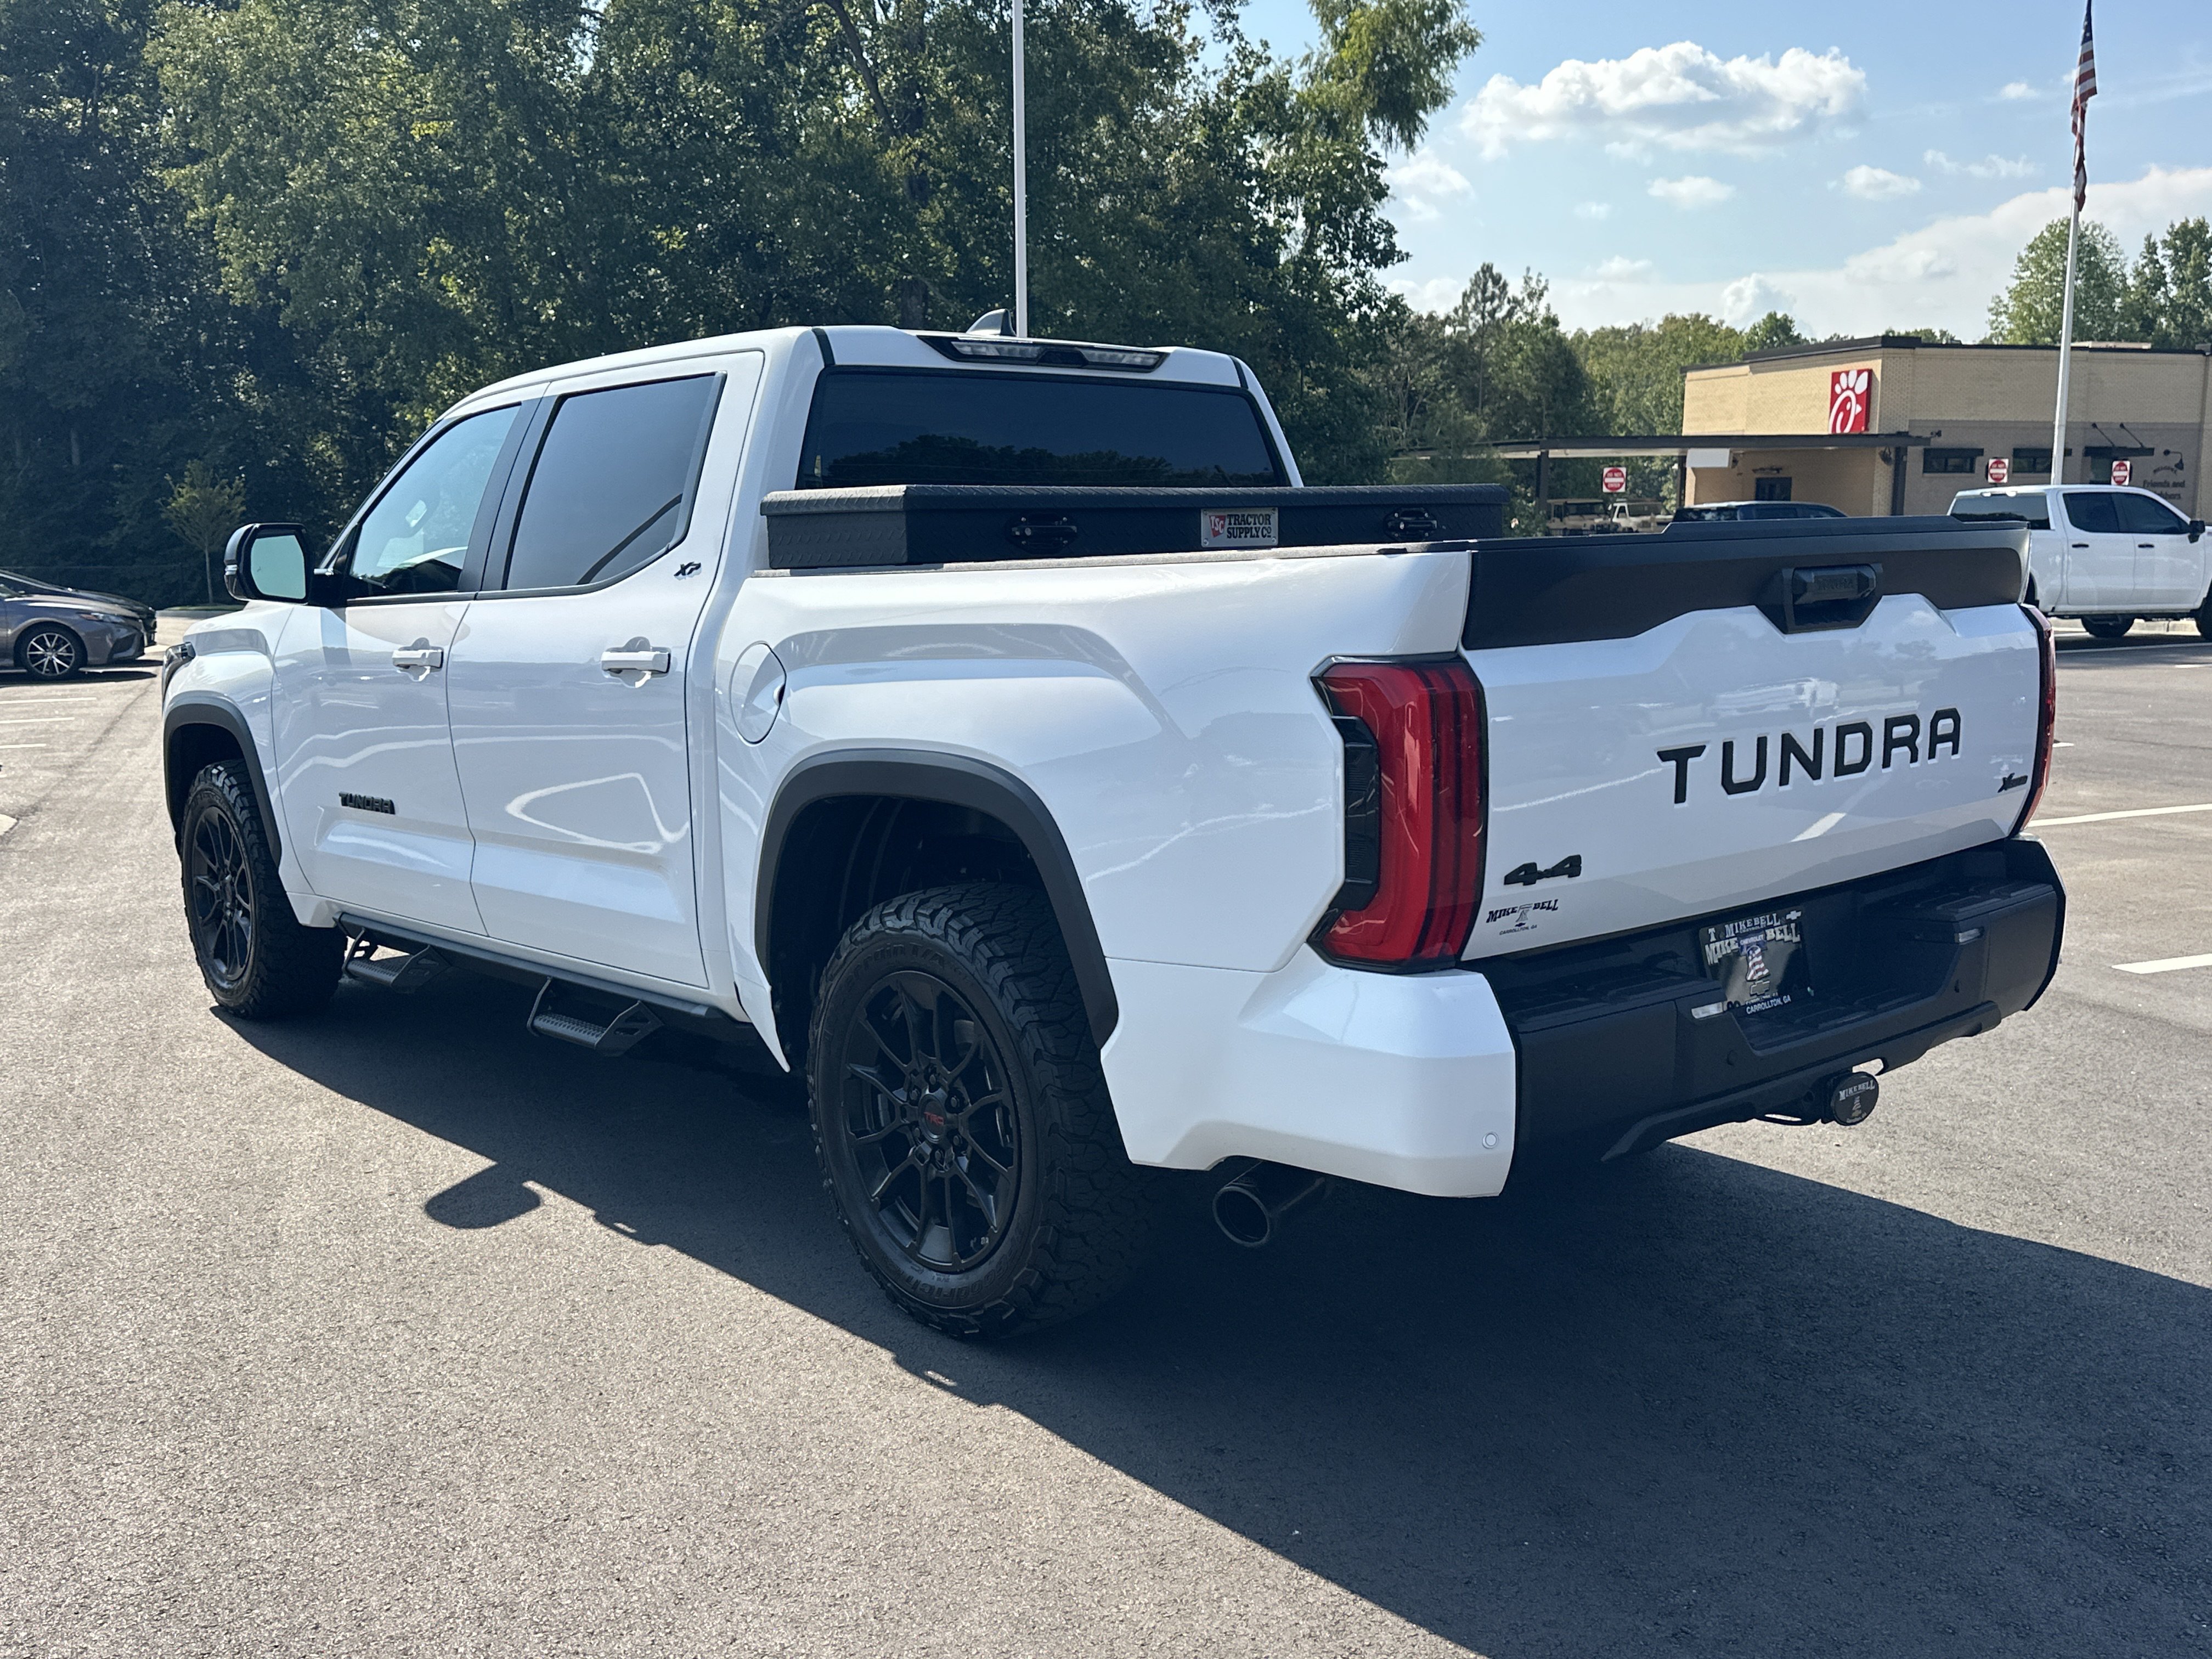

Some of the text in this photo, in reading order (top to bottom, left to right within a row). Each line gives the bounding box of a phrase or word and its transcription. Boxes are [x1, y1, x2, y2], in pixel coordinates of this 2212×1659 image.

[1210, 516, 1224, 533] TSC
[1227, 514, 1271, 526] TRACTOR
[1227, 526, 1260, 539] SUPPLY
[1656, 707, 1962, 805] TUNDRA
[338, 792, 396, 815] TUNDRA
[1486, 899, 1558, 923] MIKE BELL
[1724, 913, 1781, 938] MIKE BELL
[1705, 937, 1739, 966] MIKE
[1765, 923, 1801, 943] BELL
[1839, 1080, 1876, 1101] MIKE BELL
